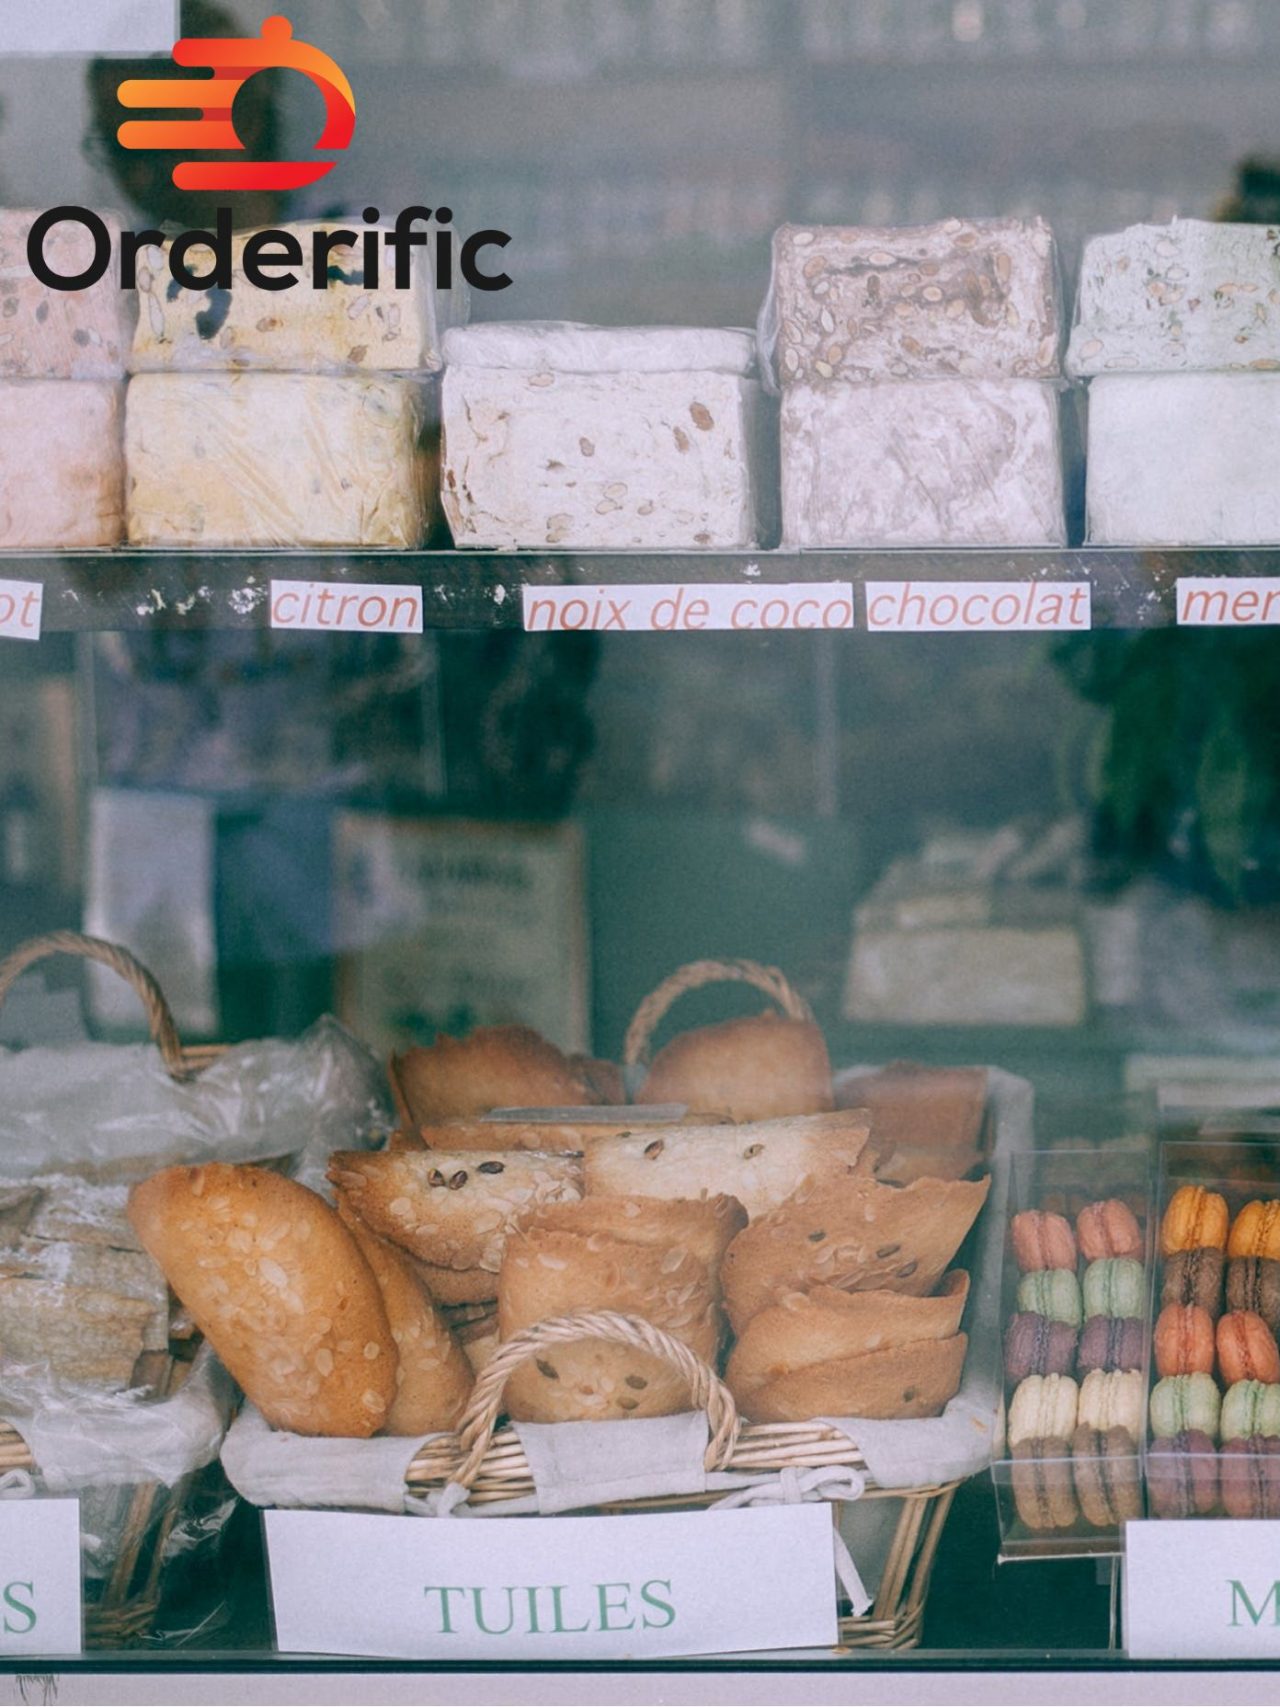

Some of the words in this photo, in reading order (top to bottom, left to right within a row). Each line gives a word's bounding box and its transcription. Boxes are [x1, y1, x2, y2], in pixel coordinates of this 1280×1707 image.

[271, 583, 419, 627] citron
[527, 589, 632, 629] noix
[650, 588, 710, 628] de
[731, 599, 852, 628] coco
[868, 582, 1088, 625] chocolat
[424, 1580, 677, 1634] TUILES
